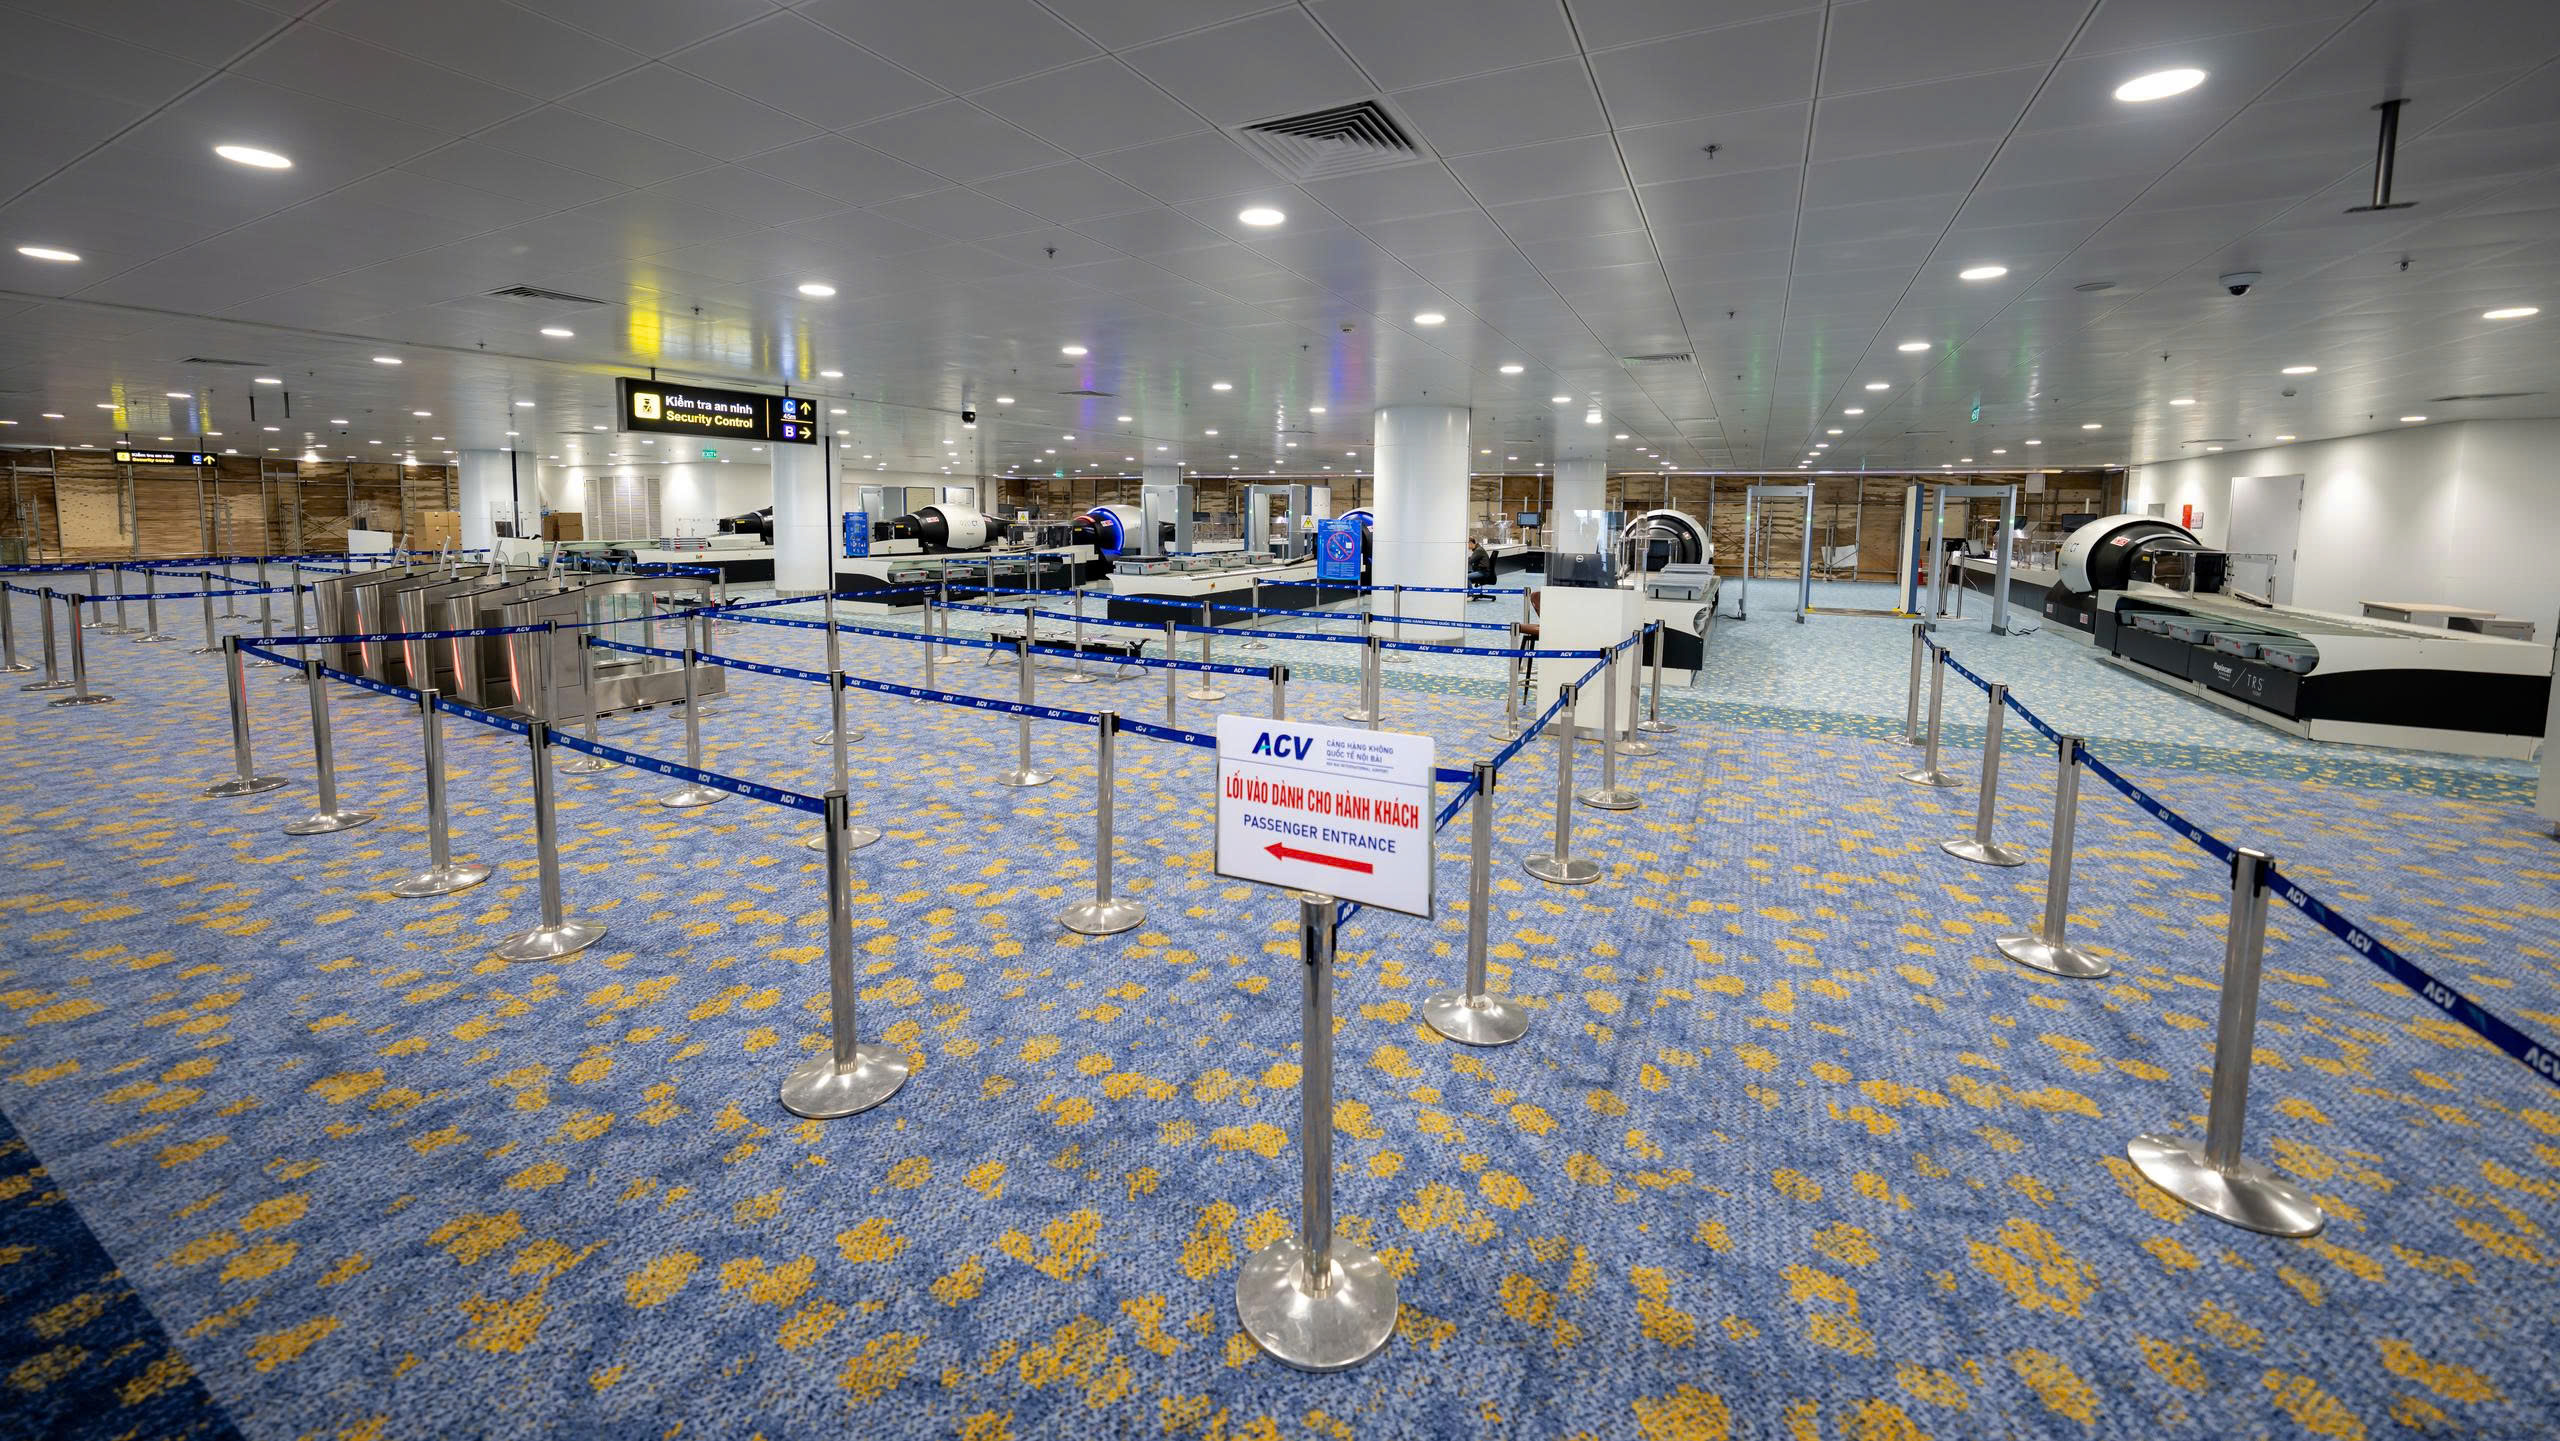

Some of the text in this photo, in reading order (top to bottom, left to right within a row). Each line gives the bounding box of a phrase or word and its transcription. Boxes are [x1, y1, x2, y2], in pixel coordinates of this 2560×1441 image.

[665, 394, 753, 415] Kiểm tra an ninh
[784, 401, 794, 412] C
[666, 411, 753, 429] Security Control
[785, 425, 794, 437] B
[2247, 673, 2263, 691] TRS
[909, 688, 922, 696] ACV
[942, 694, 954, 702] ACV
[975, 700, 988, 708] ACV
[1010, 704, 1024, 712] ACV
[1047, 709, 1061, 718] ACV
[1252, 731, 1314, 761] ACV
[1326, 748, 1382, 763] QUỐC TẾ NỘI BÀI
[1347, 742, 1367, 751] HÀNG
[1369, 744, 1394, 754] KHÔNG
[592, 746, 604, 755] ACV
[624, 755, 637, 764] ACV
[659, 764, 672, 774] ACV
[698, 773, 711, 783] ACV
[737, 783, 752, 794] ACV
[780, 794, 796, 805] ACV
[1226, 770, 1243, 800] LỐI
[1246, 776, 1268, 804] VÀO
[1272, 780, 1304, 810] DÀNH
[1307, 789, 1332, 815] CHO
[1335, 790, 1370, 821] HÀNH
[1374, 797, 1420, 829] KHÁCH
[1243, 814, 1397, 853] PASSENGER ENTRANCE
[2158, 808, 2169, 821] ACV
[2189, 828, 2202, 842] ACV
[2286, 886, 2307, 907] ACV
[2346, 929, 2372, 953] ACV
[2423, 981, 2456, 1009] ACV
